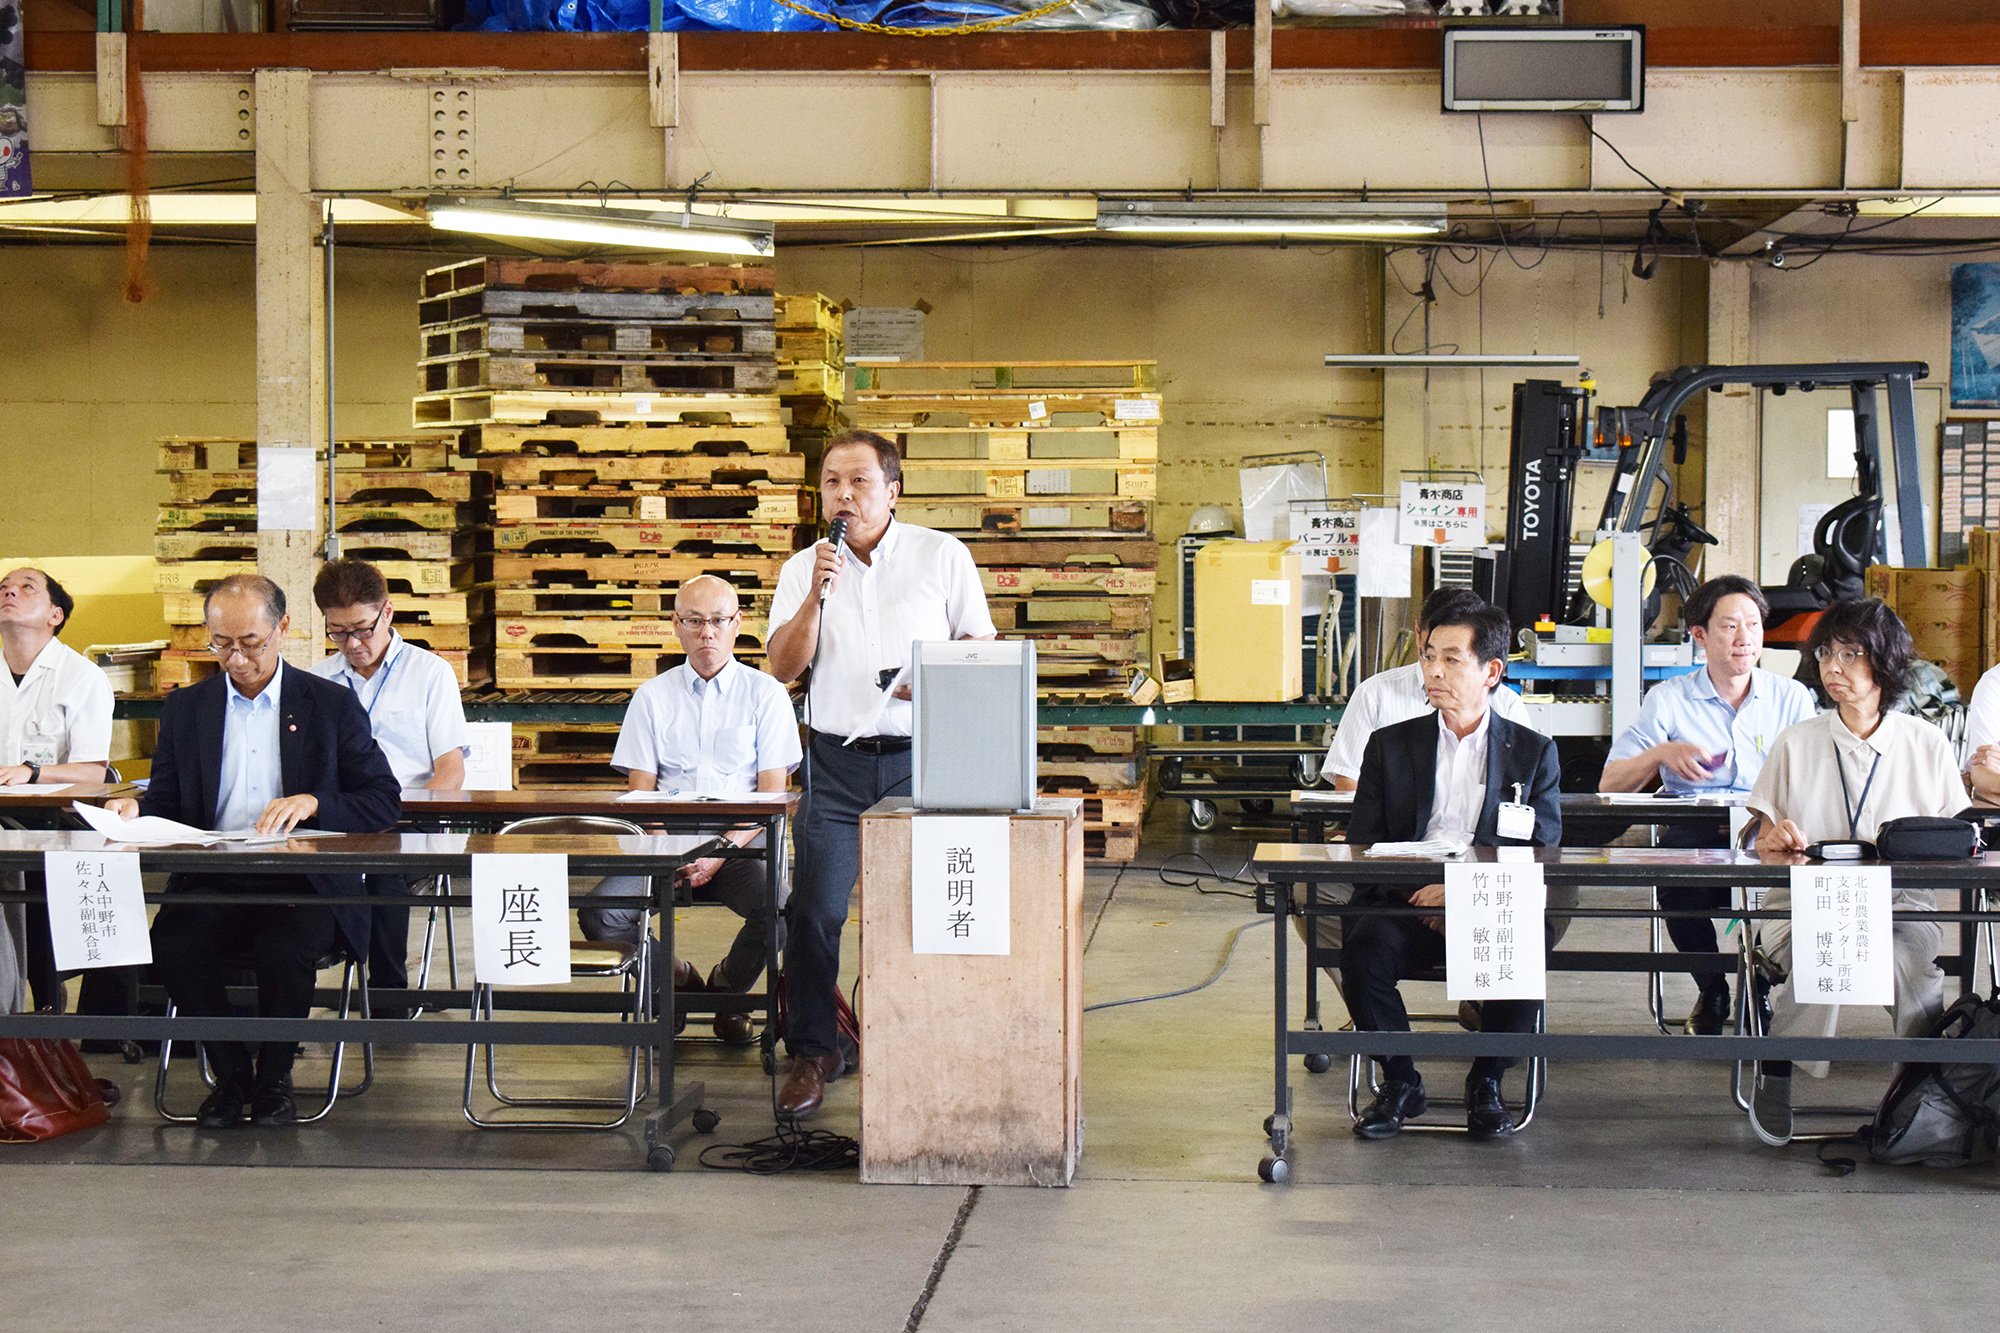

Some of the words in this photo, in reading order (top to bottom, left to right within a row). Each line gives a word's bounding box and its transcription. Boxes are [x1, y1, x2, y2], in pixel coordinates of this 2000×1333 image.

[1407, 503, 1477, 517] シャイン専用
[1420, 488, 1463, 500] 青木商店
[1522, 458, 1542, 541] TOYOTA
[639, 531, 662, 543] Dole
[1311, 517, 1355, 528] 青木商店
[997, 574, 1019, 587] Dole
[1106, 579, 1125, 588] MLS
[97, 863, 117, 938] JA中野市
[946, 847, 975, 938] 説明者
[1472, 872, 1490, 907] 竹内
[1815, 876, 1832, 910] 町田
[75, 860, 101, 961] 佐々木副組合長
[499, 884, 543, 969] 座長
[1496, 872, 1514, 981] 中野市副市長
[1854, 875, 1869, 962] 北信農業農村
[1473, 927, 1491, 962] 敏昭
[1816, 931, 1833, 968] 博美
[1836, 875, 1852, 993] 支援センター所長
[1474, 972, 1491, 988] 様
[1816, 977, 1834, 993] 様
